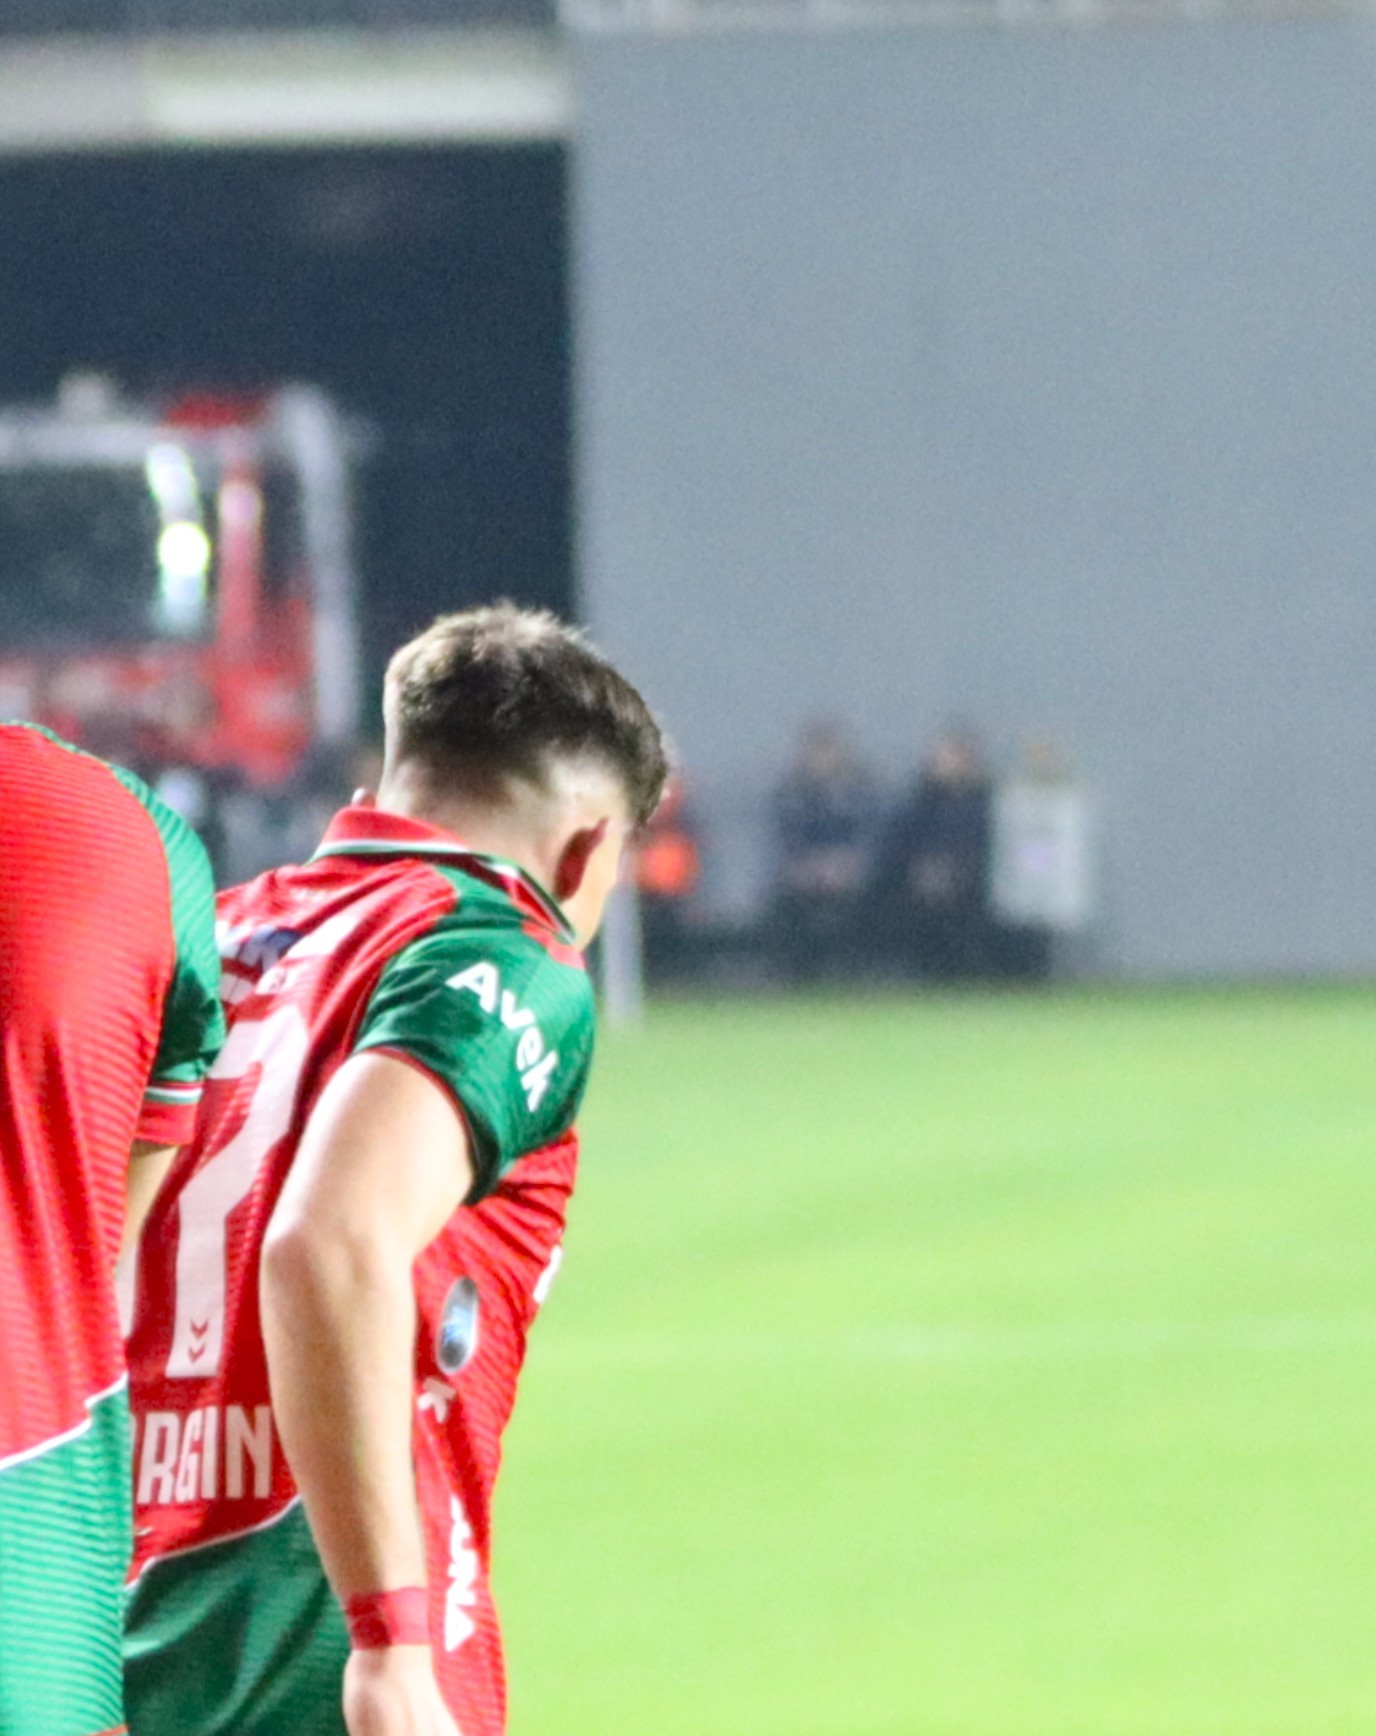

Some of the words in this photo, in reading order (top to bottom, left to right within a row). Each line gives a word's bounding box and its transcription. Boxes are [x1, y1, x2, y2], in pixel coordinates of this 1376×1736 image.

[443, 960, 559, 1113] Avek
[115, 1005, 308, 1378] 7
[129, 1404, 272, 1505] RGIN
